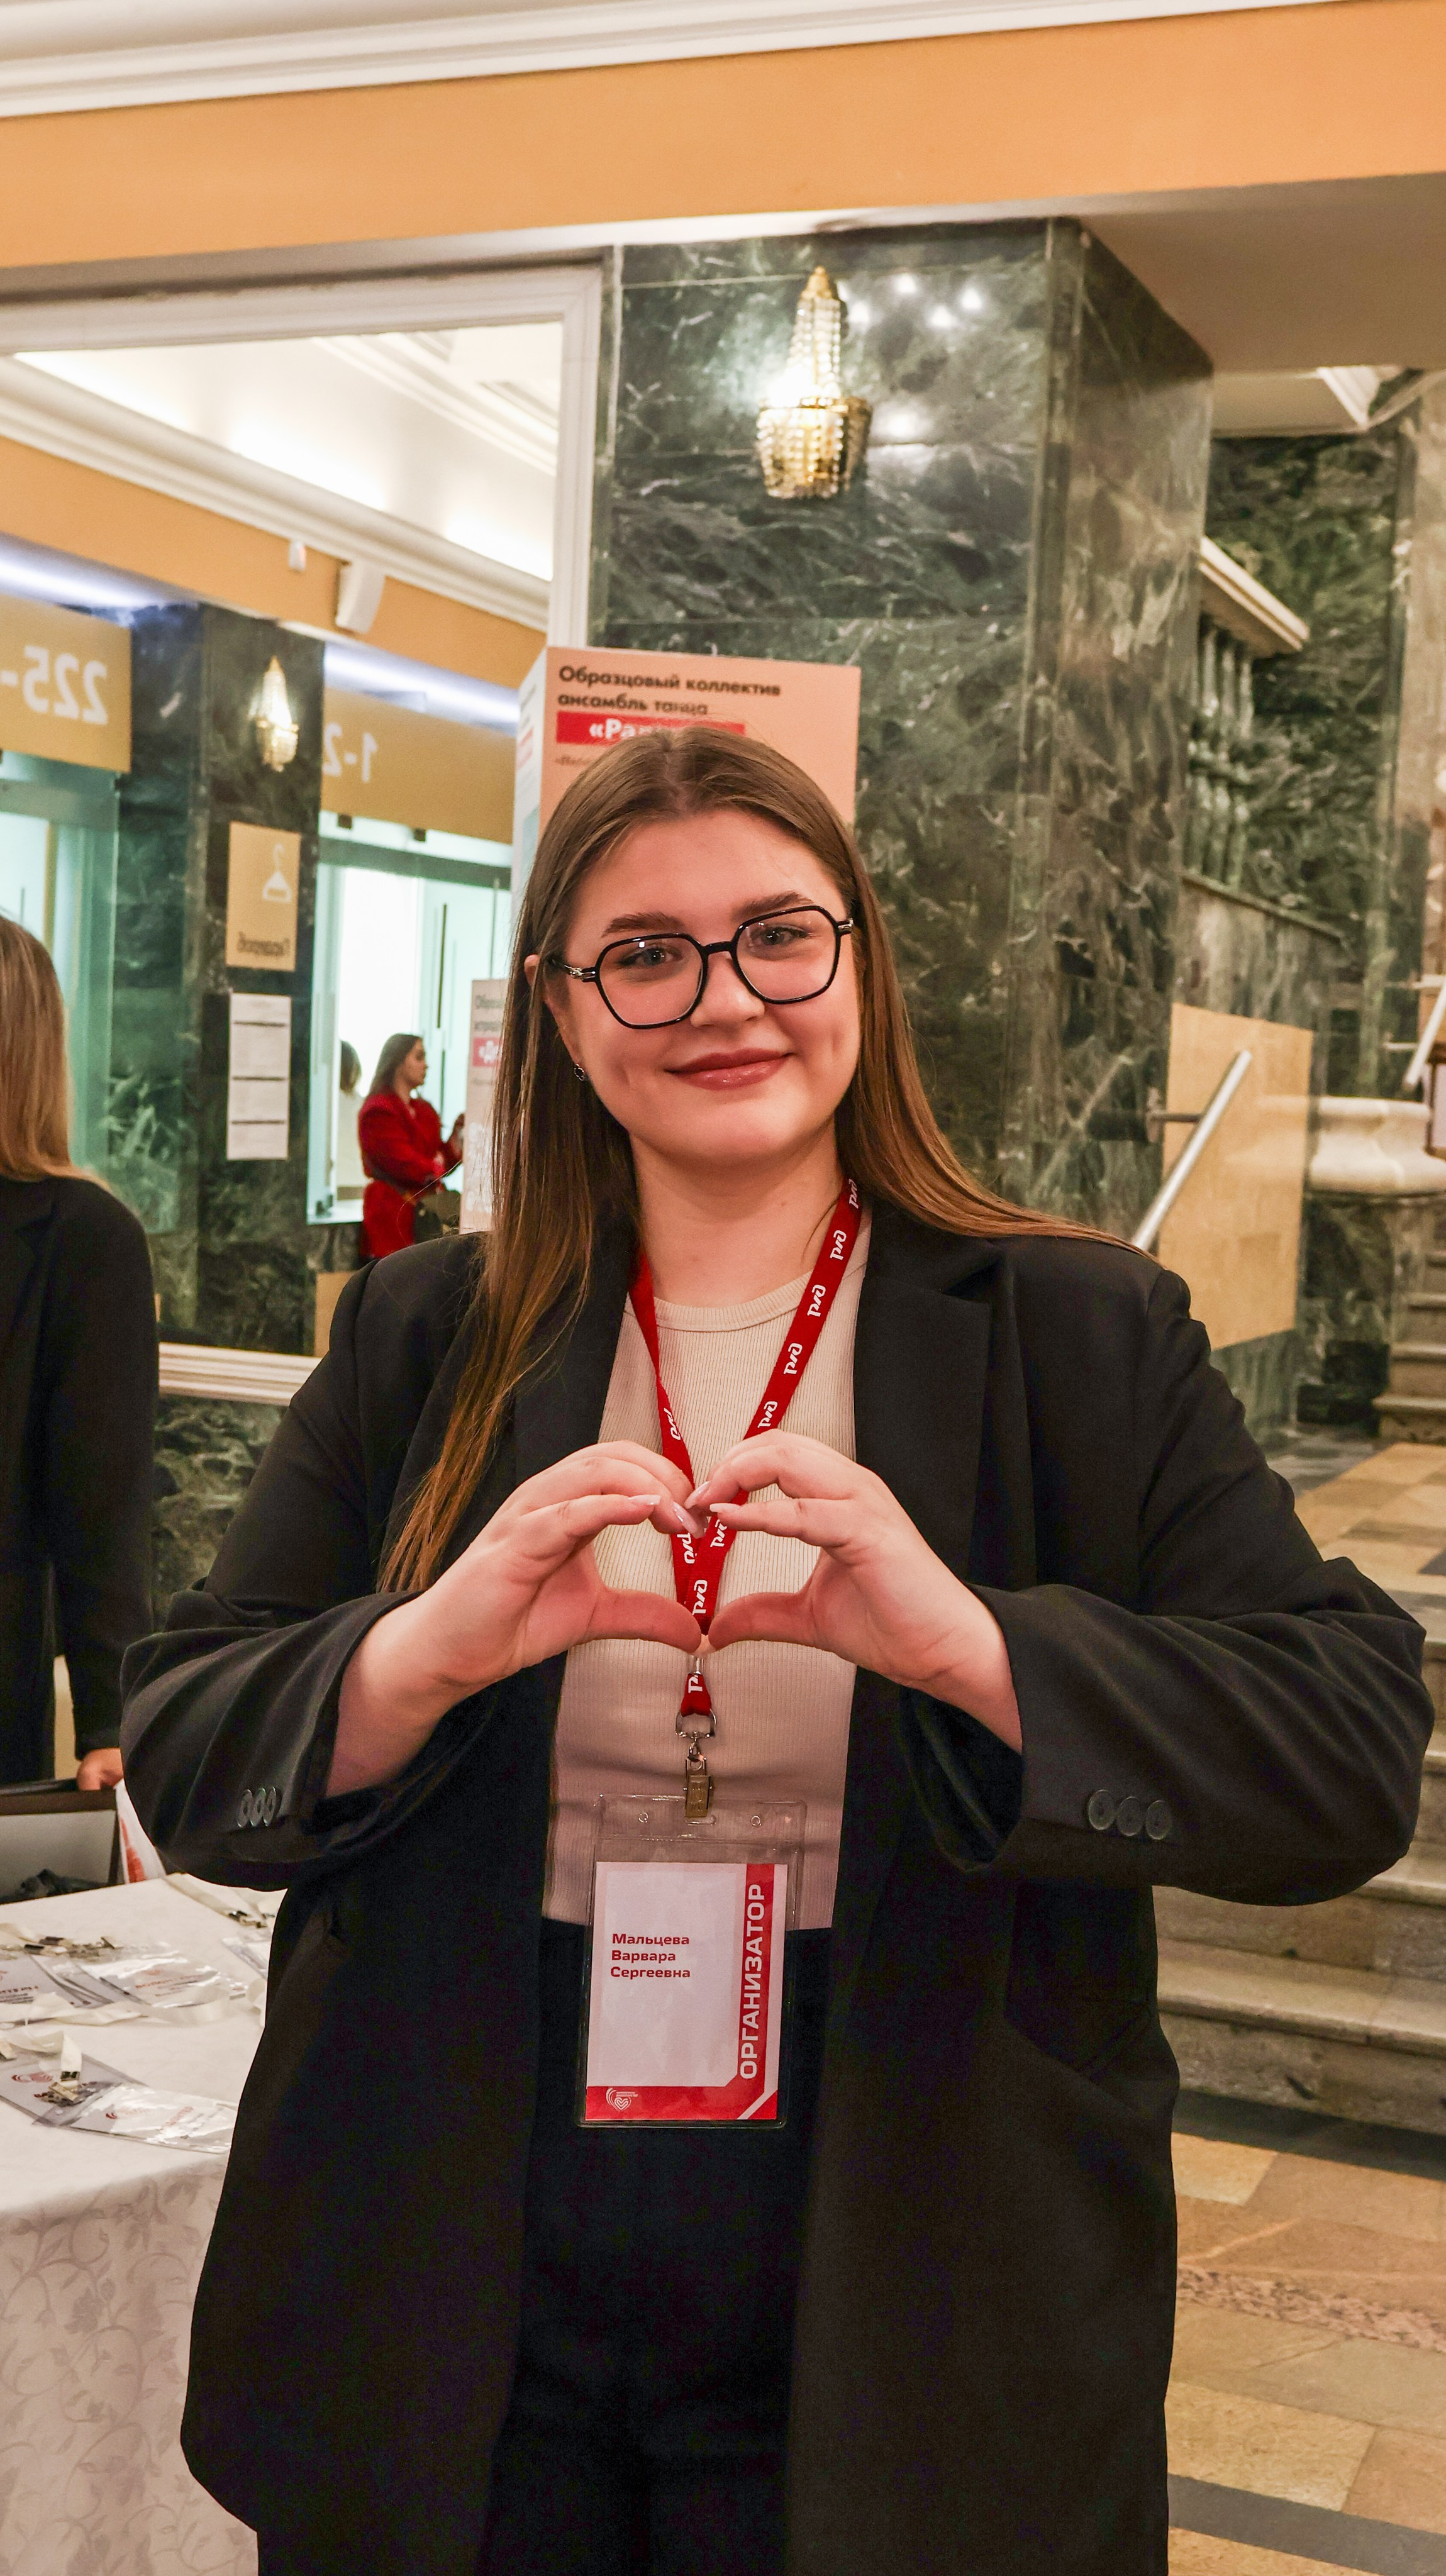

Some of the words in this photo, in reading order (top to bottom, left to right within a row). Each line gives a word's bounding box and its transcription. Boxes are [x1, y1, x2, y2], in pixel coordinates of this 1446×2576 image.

[559, 665, 680, 688] Образцовый
[686, 679, 781, 696] коллектив
[557, 693, 647, 711] ансамбль
[655, 700, 708, 716] танца
[613, 1933, 689, 1946] Мальцева
[611, 1950, 676, 1963] Варвара
[610, 1966, 691, 1980] Сергеевна
[740, 1884, 765, 2079] ОРГАНИЗАТОР
